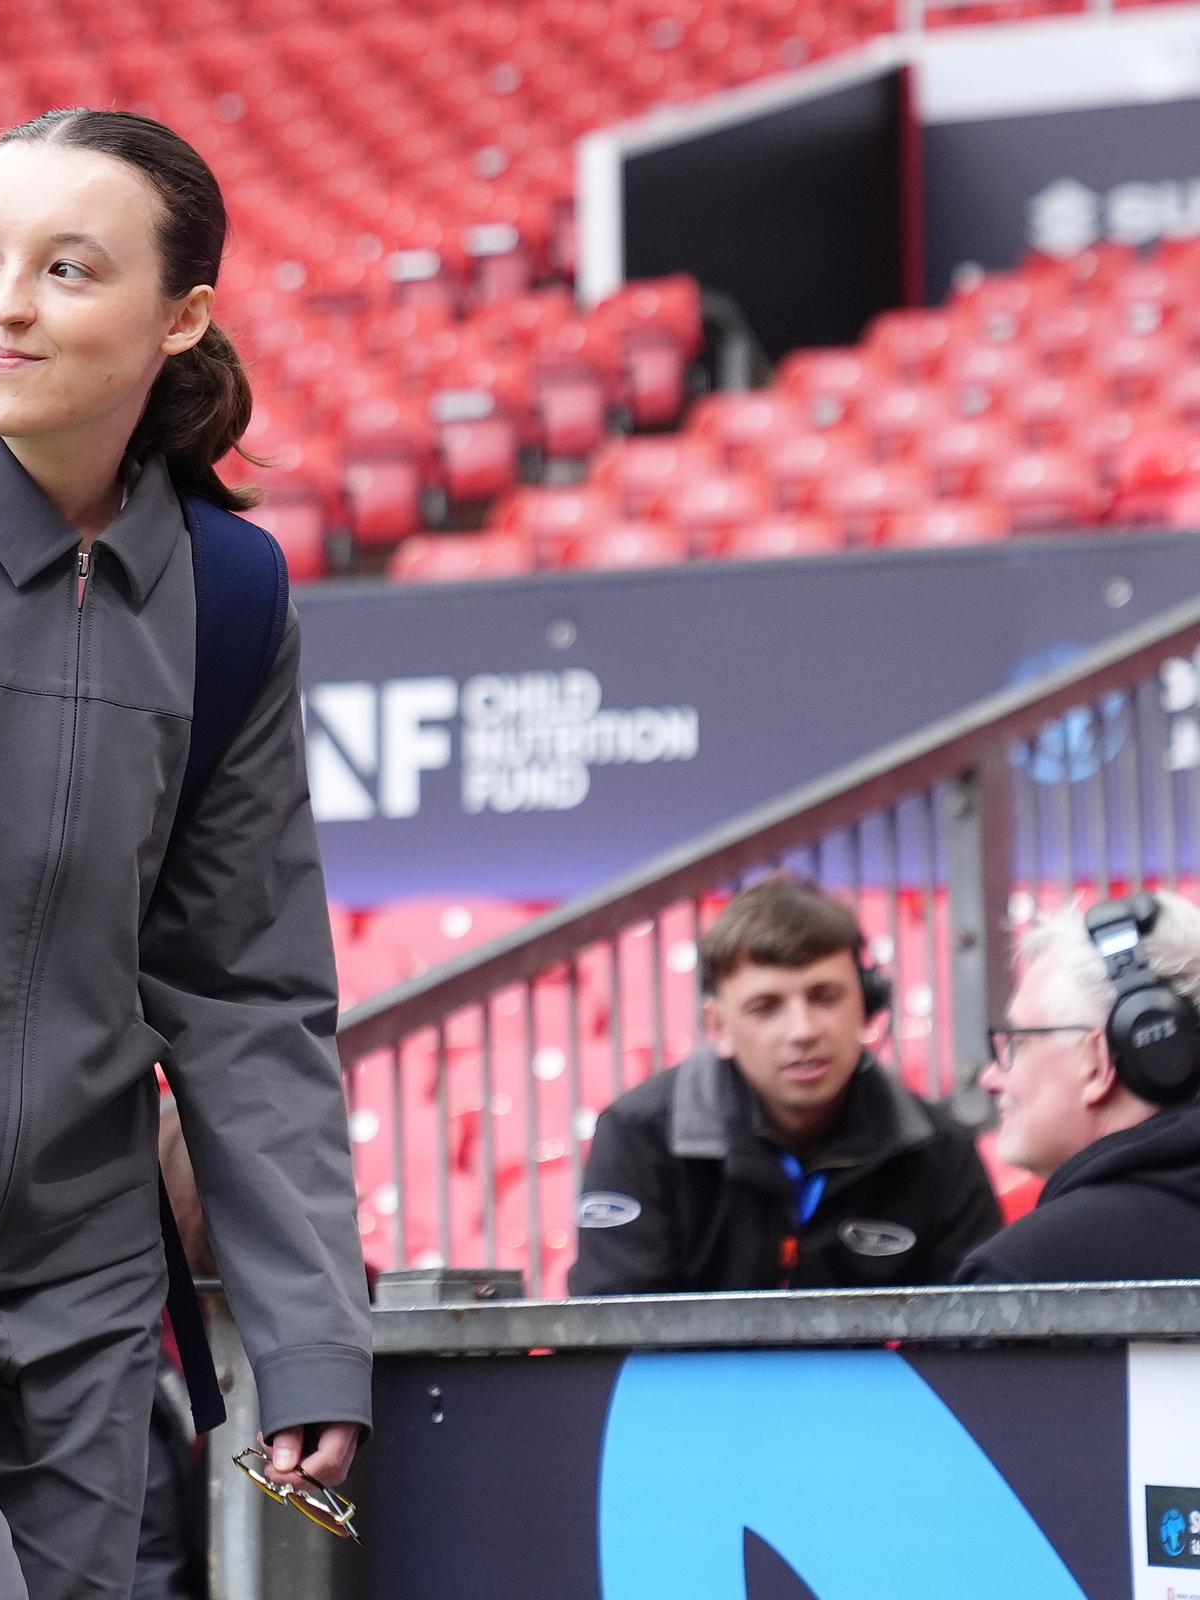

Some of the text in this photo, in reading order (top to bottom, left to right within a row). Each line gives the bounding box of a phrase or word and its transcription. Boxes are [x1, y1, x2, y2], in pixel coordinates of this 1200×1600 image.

[462, 668, 601, 724] CHILD
[461, 706, 699, 774] NUTRITION
[461, 762, 590, 815] FUND
